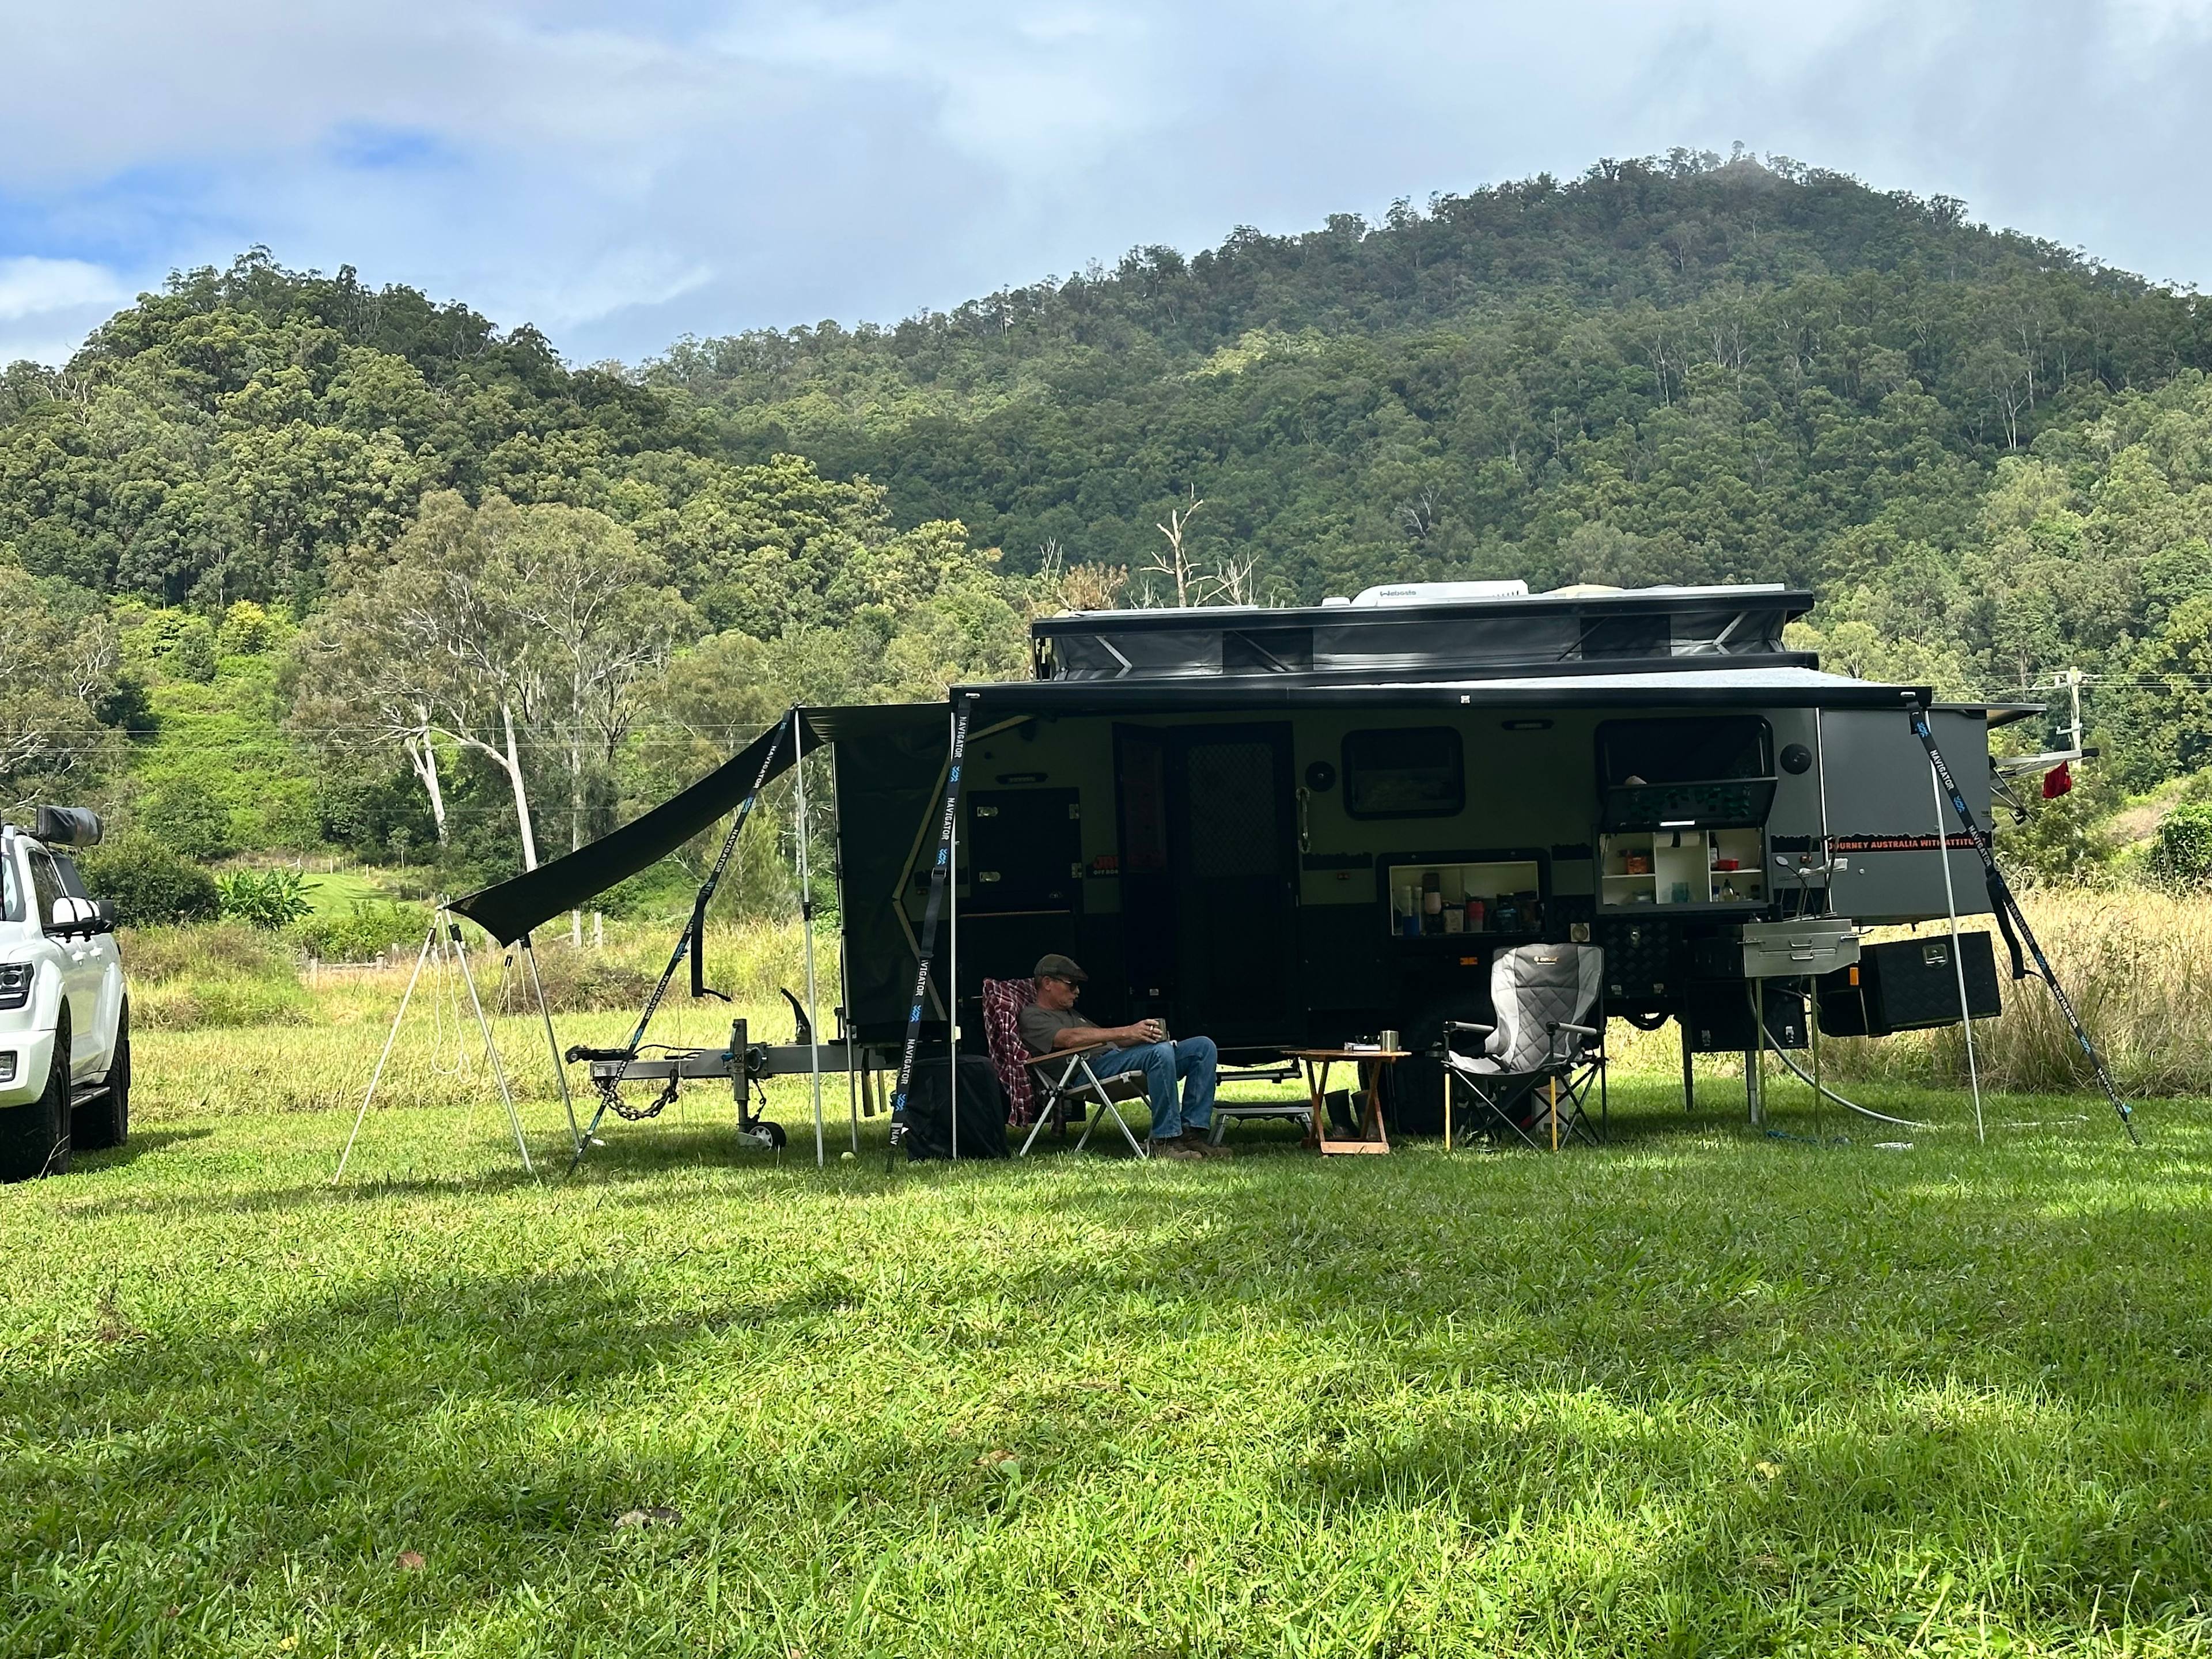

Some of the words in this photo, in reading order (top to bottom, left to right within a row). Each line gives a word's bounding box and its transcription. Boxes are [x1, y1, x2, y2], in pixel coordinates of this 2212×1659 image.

[953, 716, 967, 758] NAVIGATOR
[752, 745, 777, 789] NAVIGATOR
[1929, 748, 1955, 791] NAVIGATOR
[941, 797, 955, 840] NAVIGATOR
[714, 828, 739, 873] NAVIGATOR
[1870, 839, 1919, 849] AUSTRALIA
[1968, 824, 1992, 867] NAVIGATOR
[2008, 901, 2034, 946] NAVIGATOR
[644, 975, 669, 1020] NAVIGATOR
[2052, 982, 2078, 1029] NAVIGATOR
[900, 1038, 915, 1085] NAVIGATOR
[2097, 1066, 2123, 1113] NAVIGAOR
[889, 1128, 899, 1145] NAV
